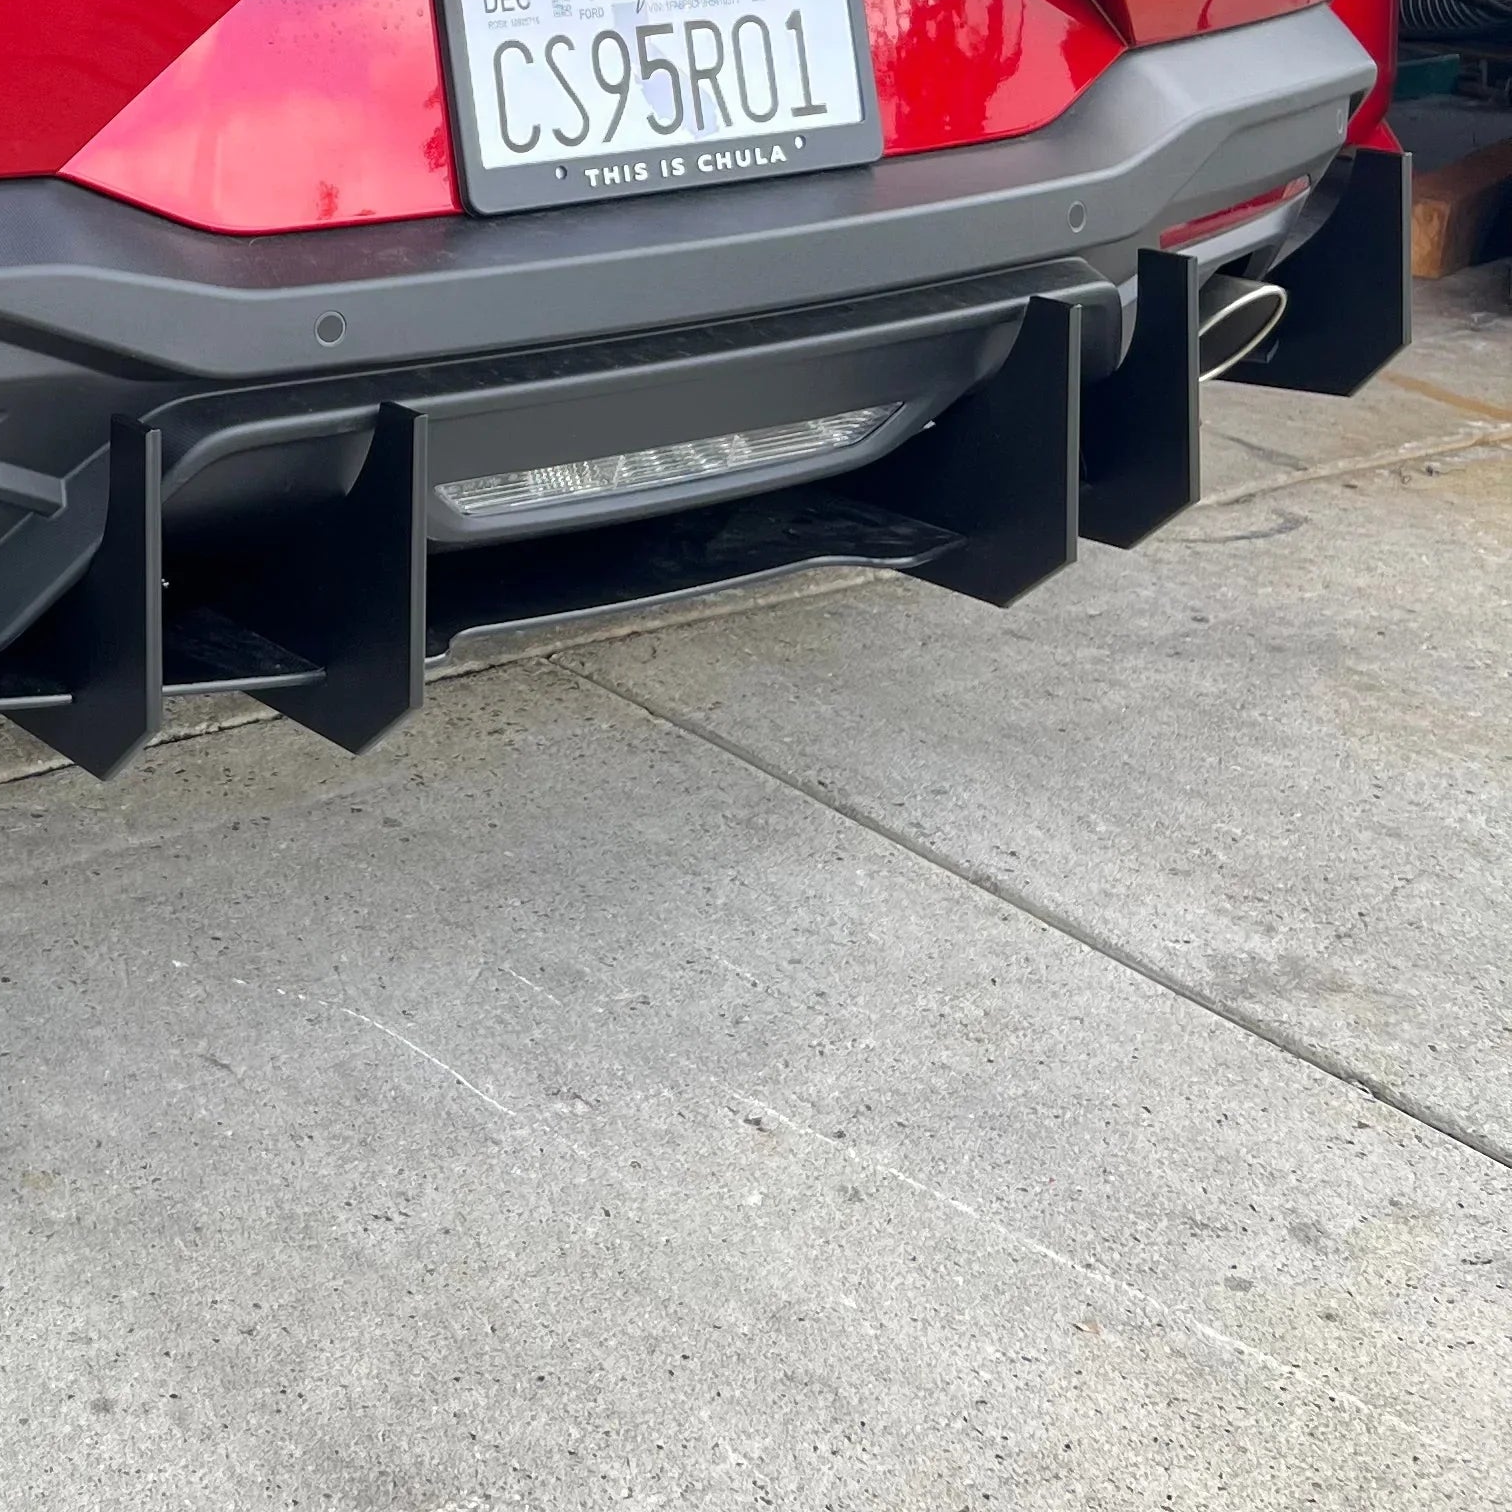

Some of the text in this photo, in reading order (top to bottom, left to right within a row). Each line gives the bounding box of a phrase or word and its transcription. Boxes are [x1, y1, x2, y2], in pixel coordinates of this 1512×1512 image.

[579, 7, 605, 20] FORD
[493, 10, 828, 154] CS95R01
[584, 145, 787, 187] THIS IS CHULA
